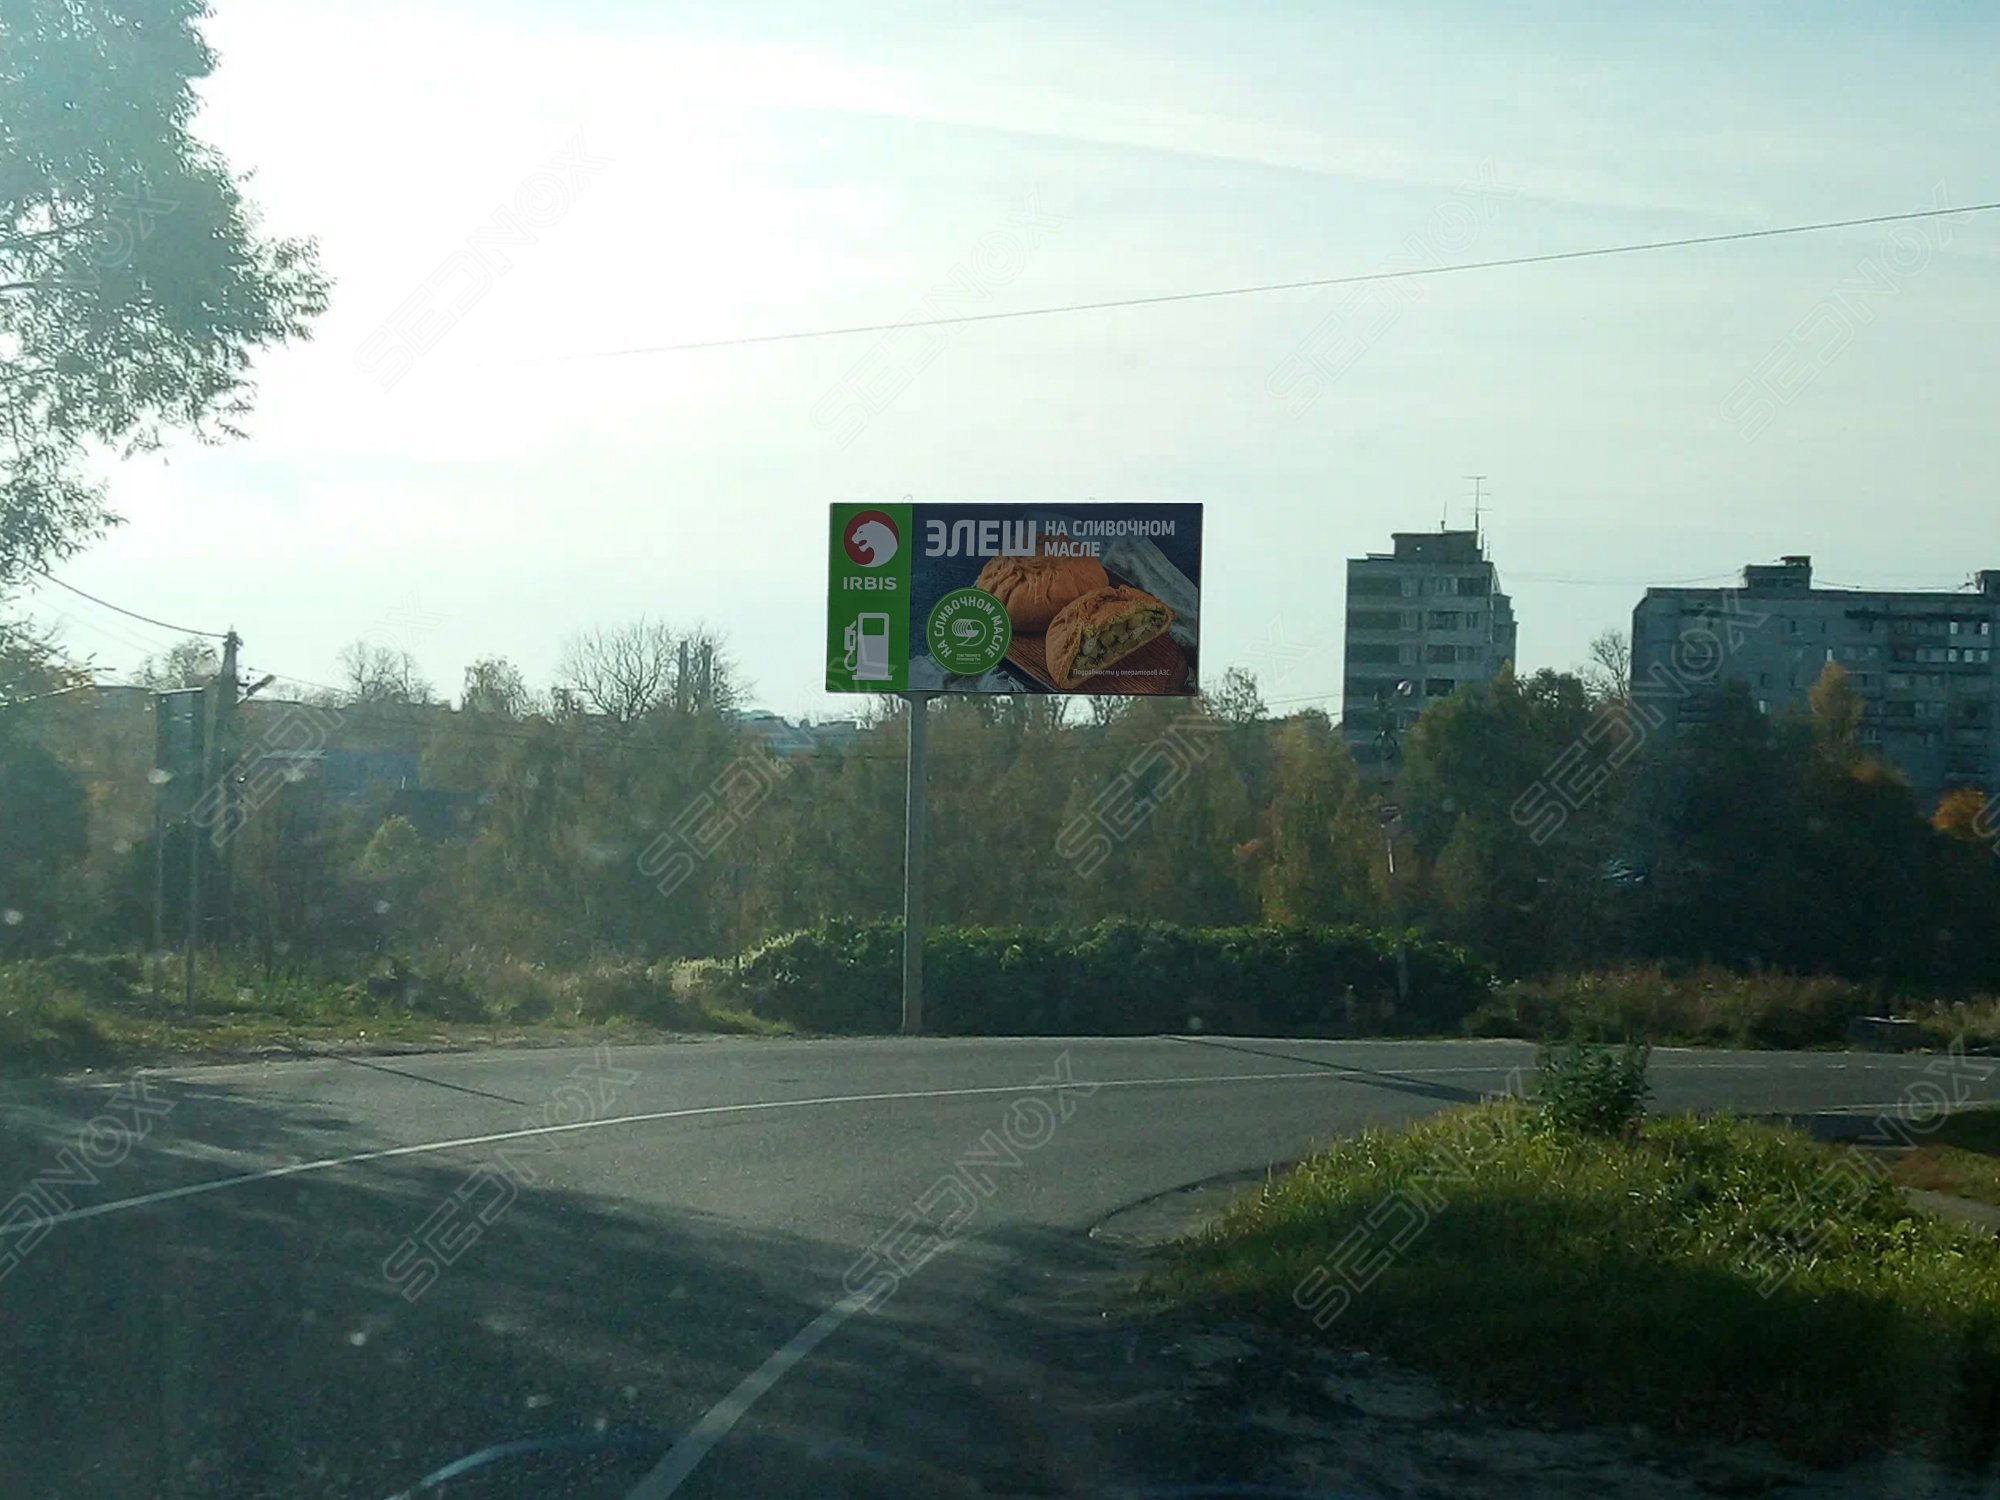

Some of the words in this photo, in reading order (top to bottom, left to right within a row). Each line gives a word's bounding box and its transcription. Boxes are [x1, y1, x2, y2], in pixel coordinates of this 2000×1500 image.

[925, 519, 1036, 557] ЭЛЕШ
[1045, 520, 1068, 536] НА
[1072, 520, 1176, 537] СЛИВОЧНОМ
[1044, 541, 1101, 557] МАСЛЕ
[843, 577, 897, 590] IRBIS
[934, 596, 995, 637] СЛИВОЧНОМ
[937, 639, 953, 658] НА
[985, 615, 1004, 658] МАСЛЕ
